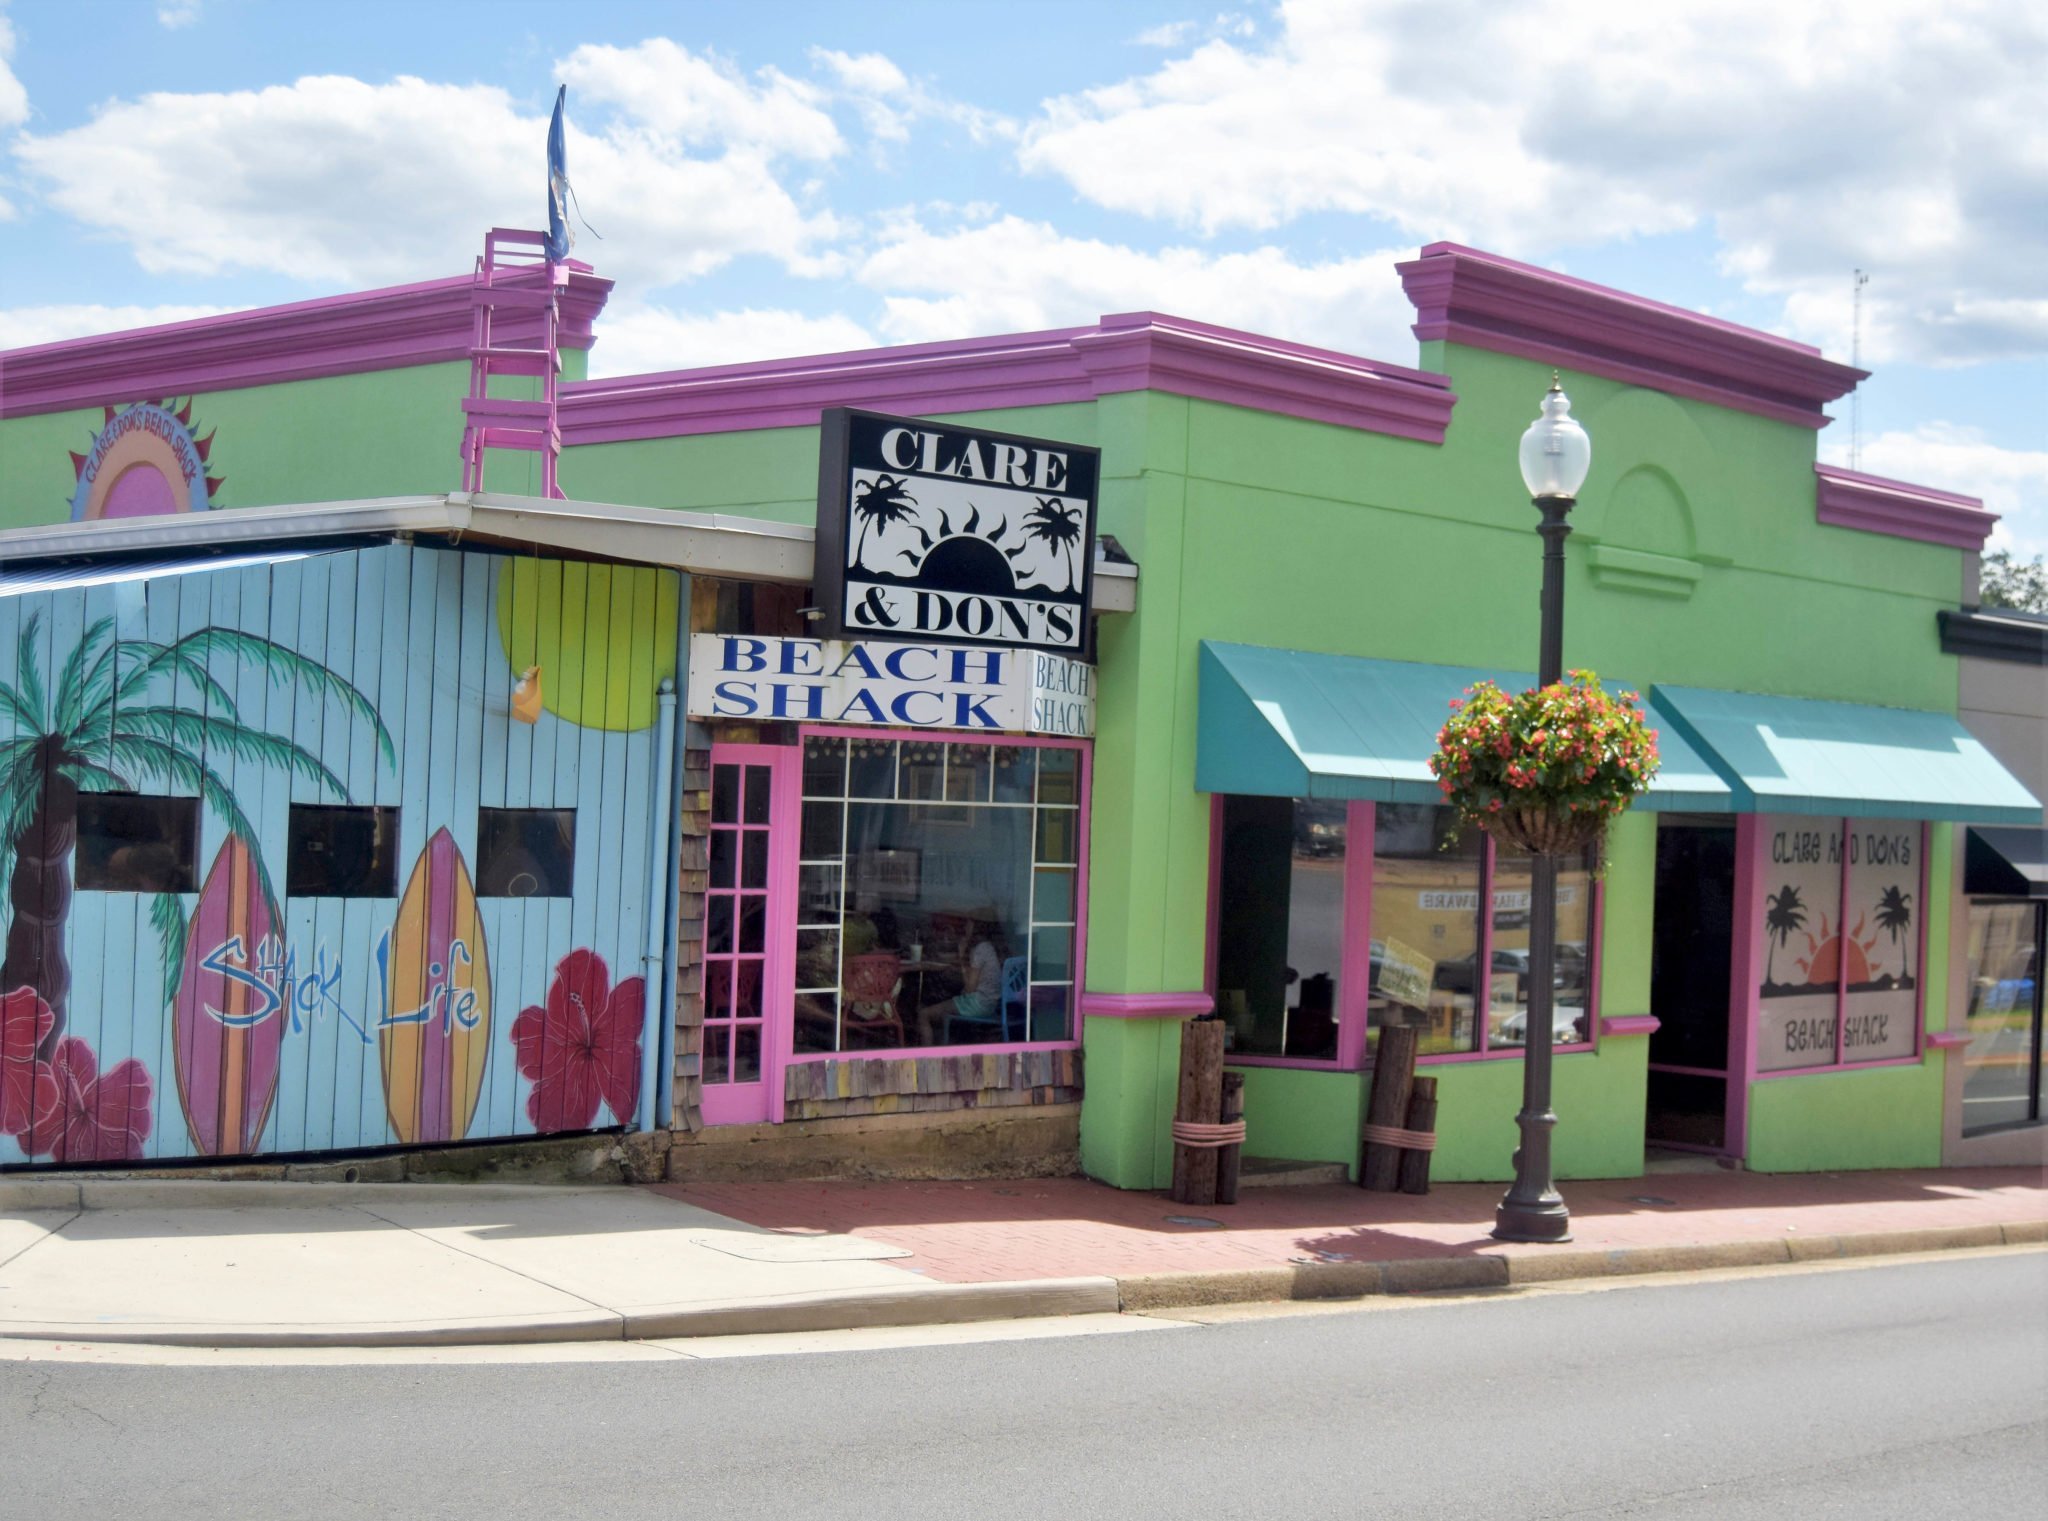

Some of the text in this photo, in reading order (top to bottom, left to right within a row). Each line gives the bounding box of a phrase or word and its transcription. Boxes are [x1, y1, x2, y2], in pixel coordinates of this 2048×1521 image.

[86, 429, 114, 483] CLARE
[118, 408, 142, 437] DON'S
[145, 411, 175, 445] BEACH
[172, 435, 196, 488] SHACK
[880, 427, 1068, 492] CLARE
[854, 586, 1074, 644] & DON'S
[716, 637, 1007, 686] BEACH
[1035, 655, 1090, 697] BEACH
[712, 681, 1003, 729] SHACK
[1033, 697, 1087, 736] SHACK
[375, 927, 481, 1037] Life
[1844, 1014, 1888, 1047] SHACK
